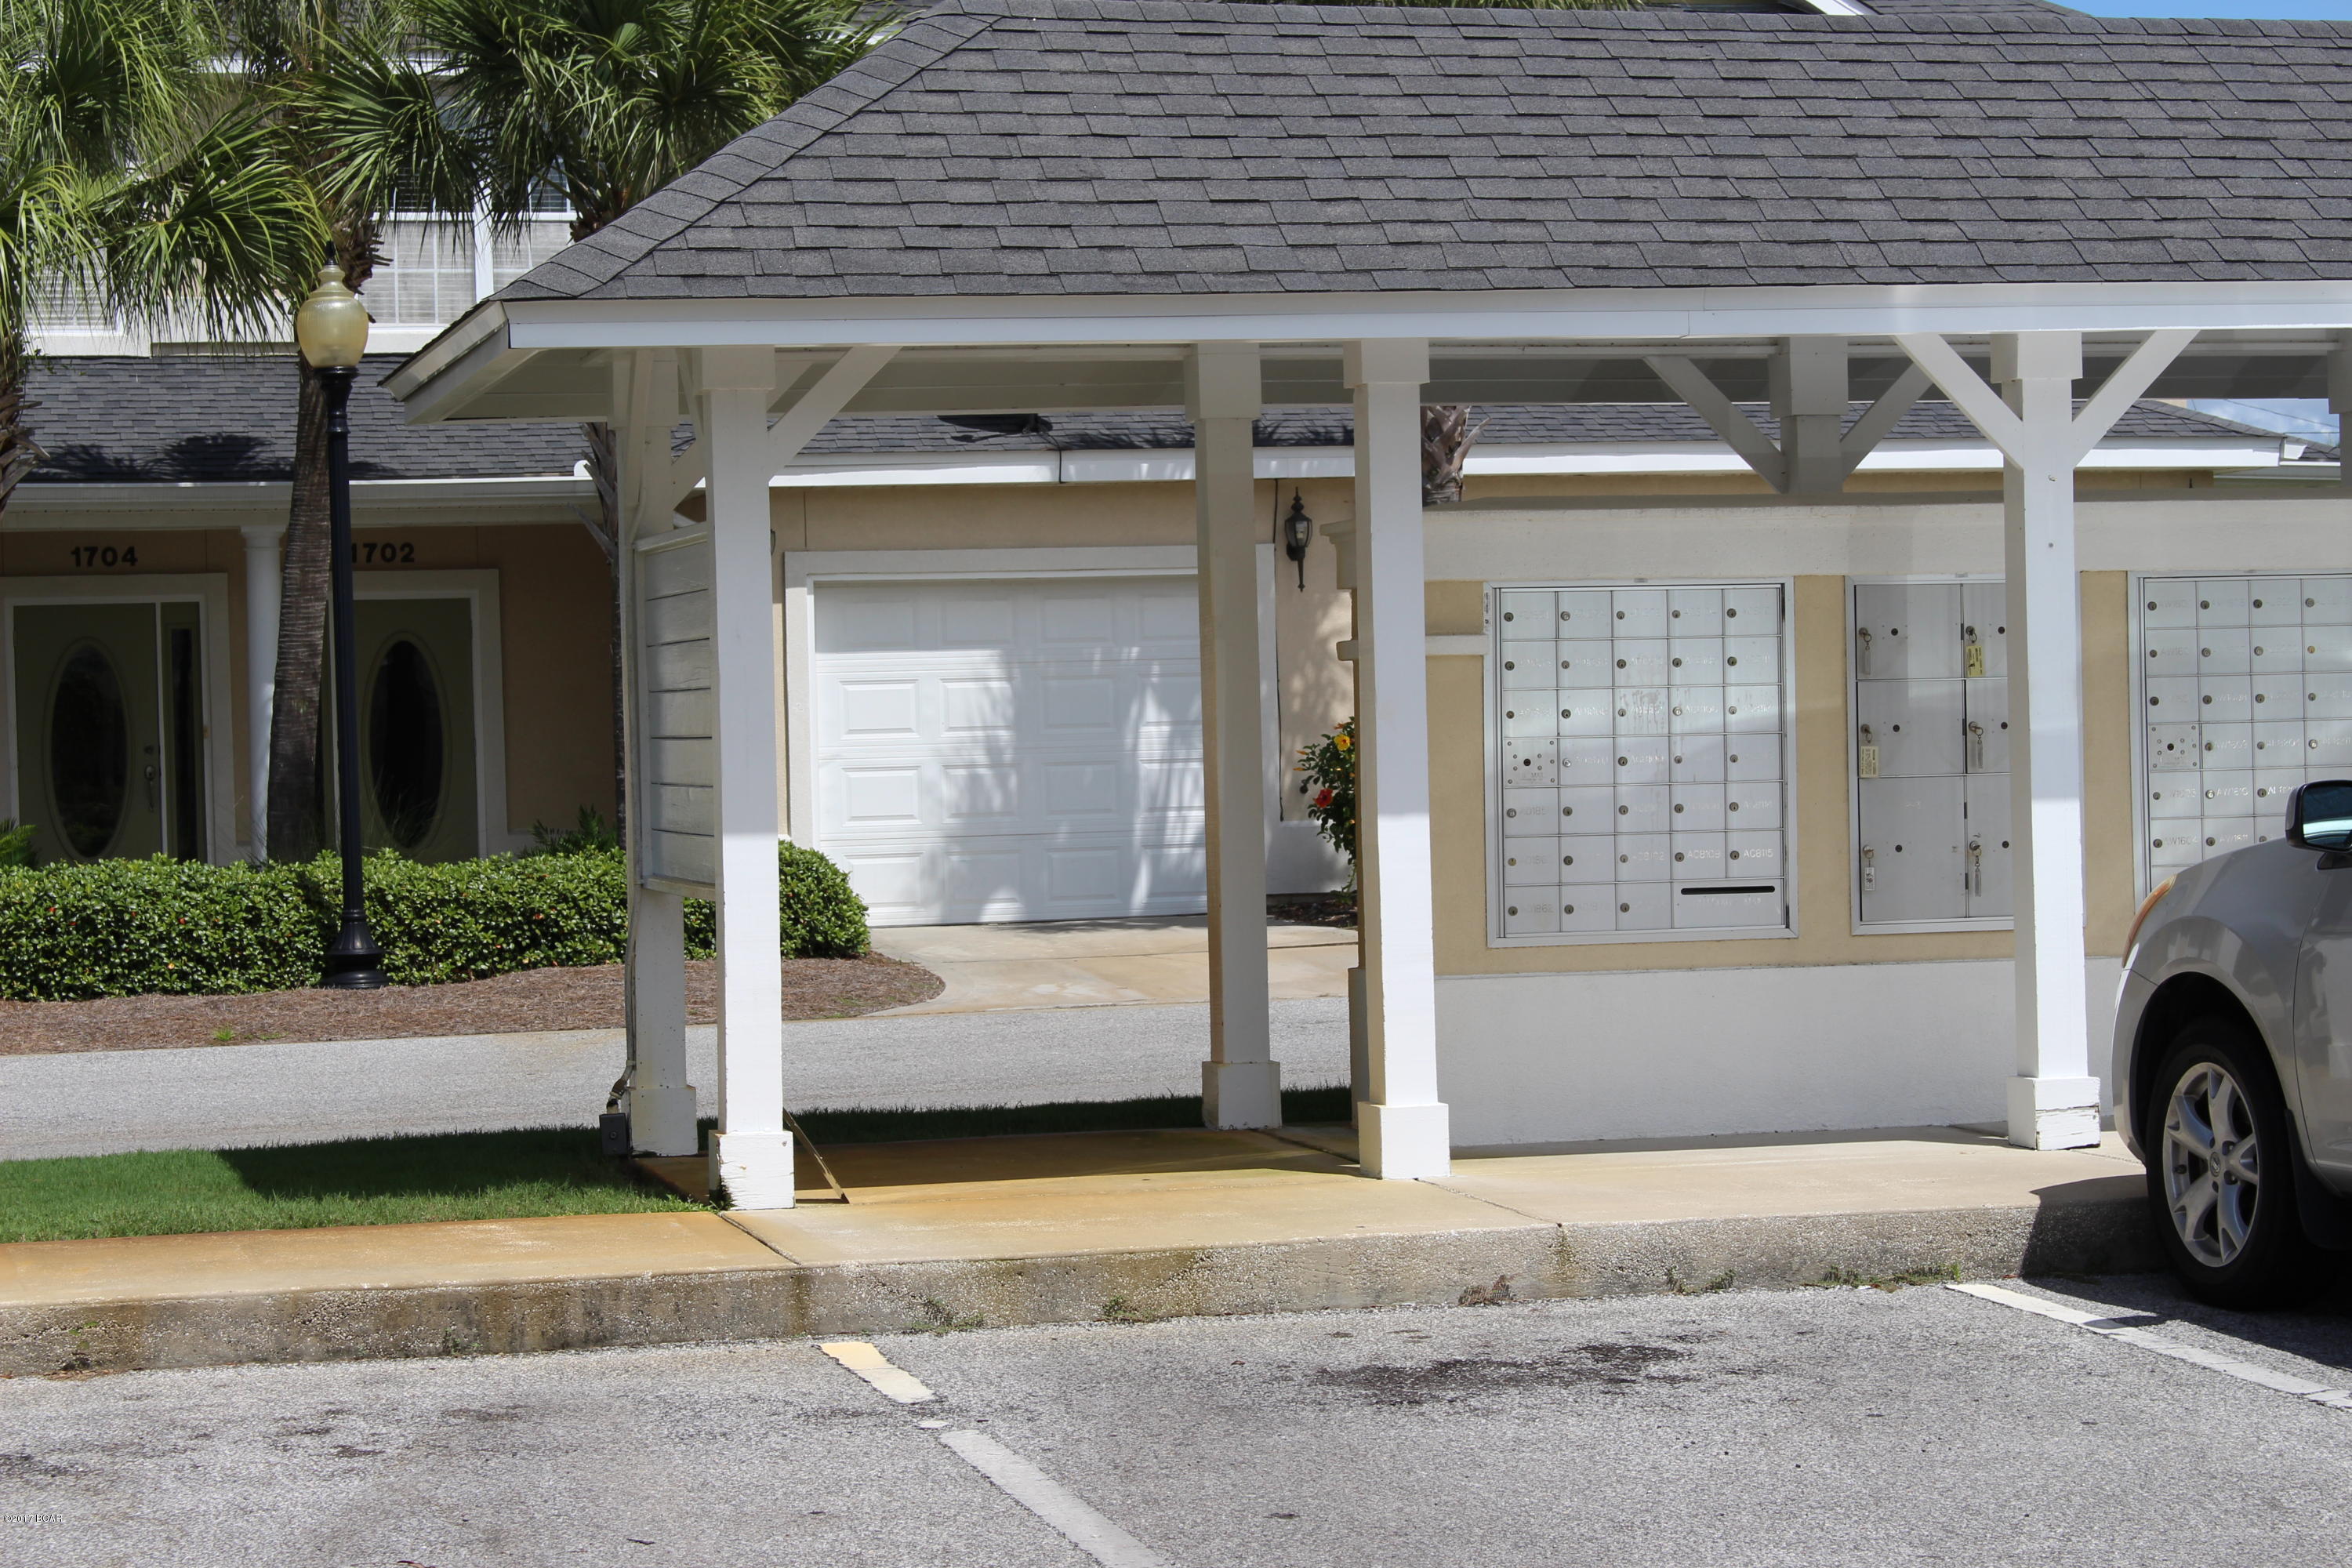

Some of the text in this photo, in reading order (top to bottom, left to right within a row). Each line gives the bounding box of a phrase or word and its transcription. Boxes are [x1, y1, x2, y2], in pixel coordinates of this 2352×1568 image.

[71, 546, 139, 567] 1704
[351, 543, 415, 564] 1702
[1743, 848, 1774, 859] AC8115
